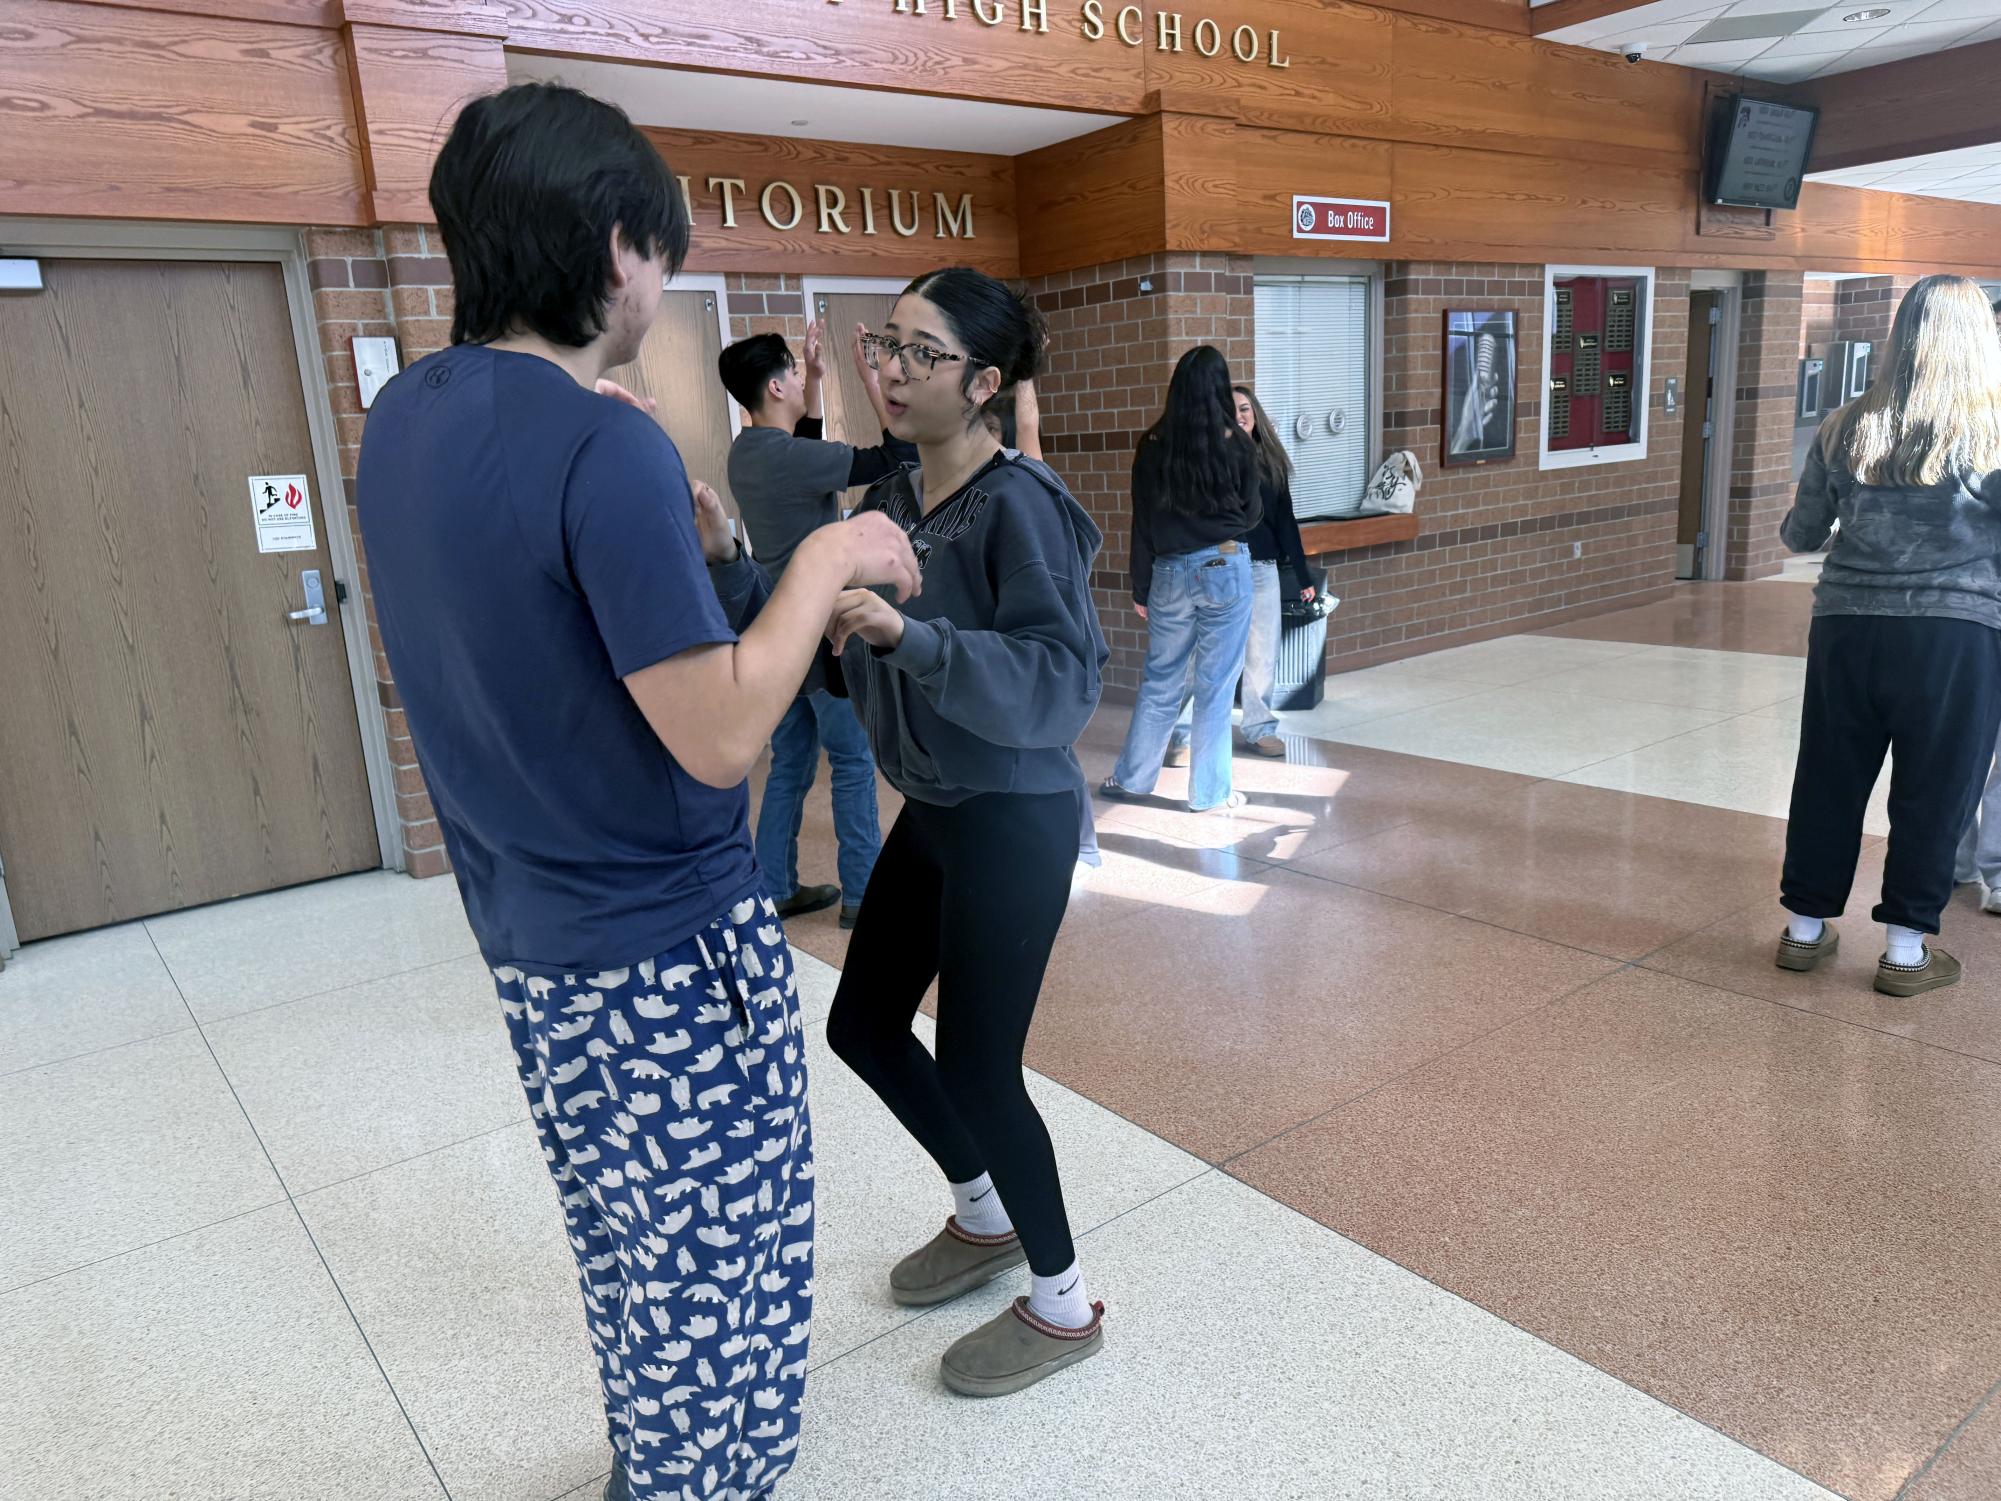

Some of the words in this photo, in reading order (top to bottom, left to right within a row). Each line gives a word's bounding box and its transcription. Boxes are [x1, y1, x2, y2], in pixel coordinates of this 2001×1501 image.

[1082, 0, 1290, 68] SCHOOL
[675, 175, 977, 239] ITORIUM
[1328, 210, 1345, 228] Box
[1347, 211, 1374, 229] Office
